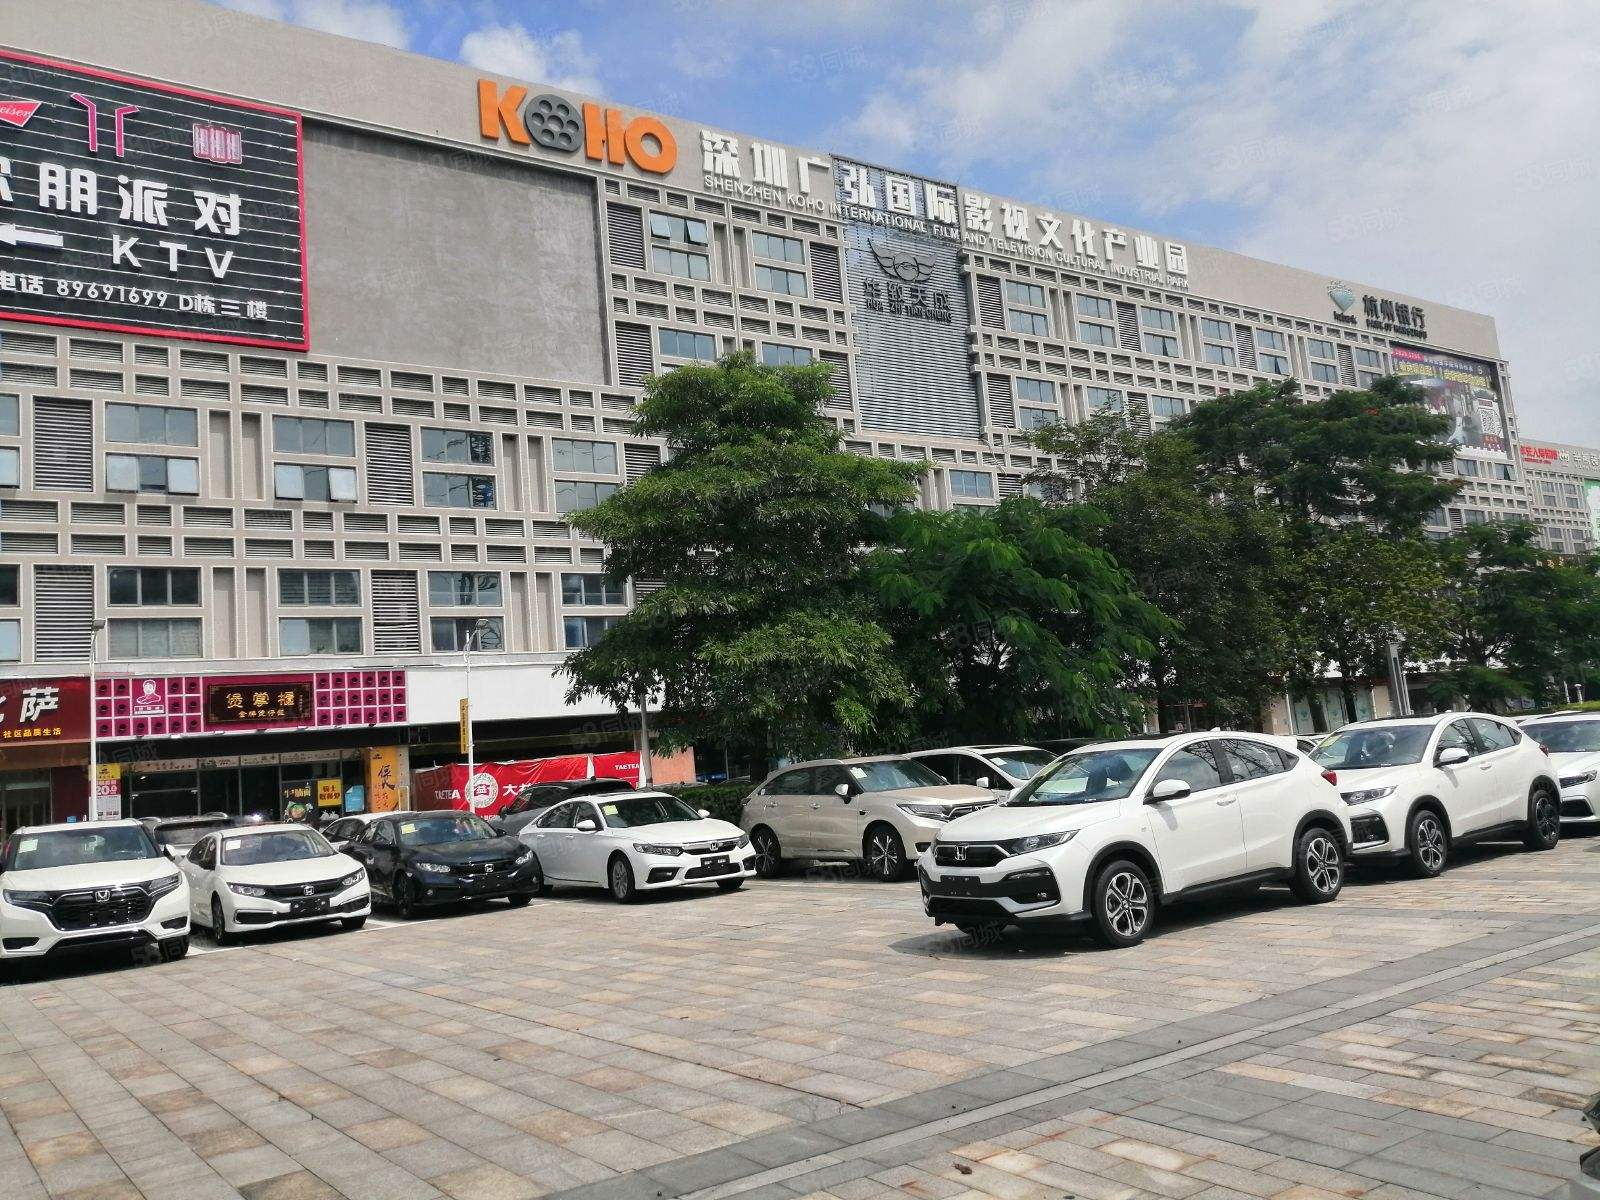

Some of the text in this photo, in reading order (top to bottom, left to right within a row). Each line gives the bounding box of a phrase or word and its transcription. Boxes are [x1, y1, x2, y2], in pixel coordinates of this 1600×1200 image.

[477, 79, 677, 174] KOHO
[700, 128, 1188, 276] 深圳广弘国际影视文化产业园
[704, 174, 1190, 289] SHENZHEN KOHO INTERNATIONAL FILM AND TELEVISION CULTURAL INDUSTRIAL PARK
[0, 270, 268, 320] 电话 89691699 D栋三楼
[0, 686, 60, 723] 萨
[3, 727, 62, 738] 社区品质生活
